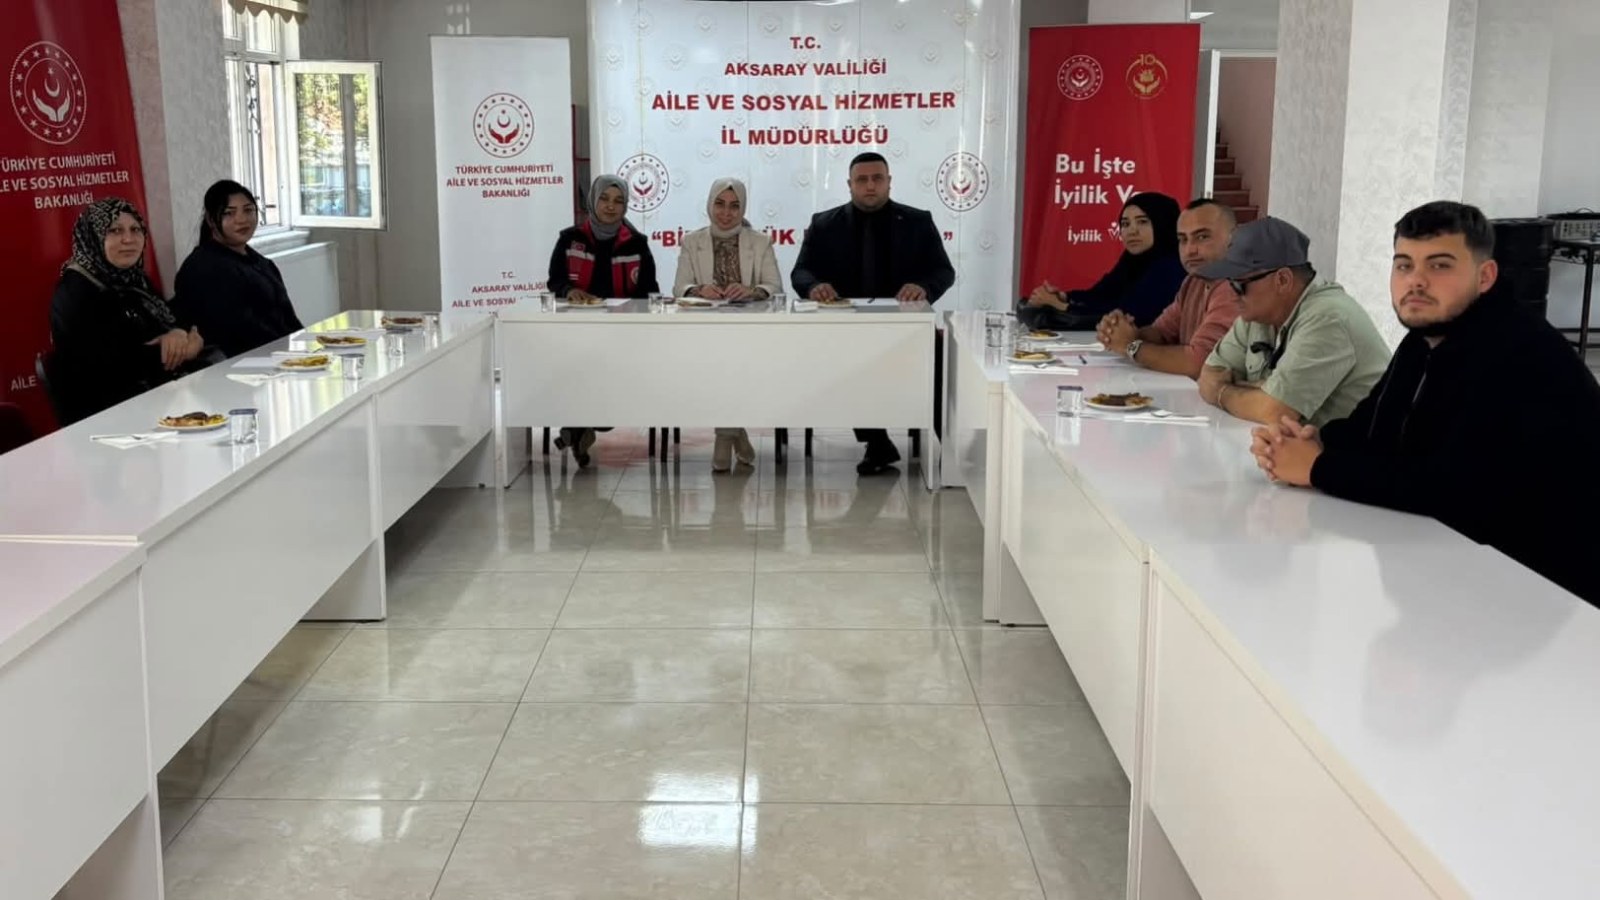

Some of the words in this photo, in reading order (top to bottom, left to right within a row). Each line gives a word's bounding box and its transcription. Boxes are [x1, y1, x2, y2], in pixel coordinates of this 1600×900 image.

[789, 36, 821, 49] T.C.
[724, 62, 807, 76] AKSARAY
[813, 58, 887, 76] VALİLİĞİ
[652, 90, 699, 110] AİLE
[706, 94, 734, 110] VE
[742, 94, 828, 111] SOSYAL
[835, 90, 956, 110] HİZMETLER
[721, 125, 741, 145] İL
[748, 125, 888, 145] MÜDÜRLÜĞÜ
[0, 155, 46, 172] ÜRKİYE
[49, 151, 116, 169] CUMHURİYETİ
[456, 164, 492, 174] TÜRKİYE
[495, 163, 554, 174] CUMHURİYETİ
[1056, 153, 1084, 174] Bu
[1094, 148, 1136, 179] İşte
[11, 177, 28, 191] VE
[30, 174, 75, 190] SOSYAL
[76, 170, 129, 187] HİZMETLER
[447, 178, 465, 187] AİLE
[467, 178, 478, 186] VE
[481, 177, 513, 186] SOSYAL
[515, 175, 563, 185] HİZMETLER
[34, 189, 94, 209] BAKANLIĞI
[482, 188, 530, 198] BAKANLIĞI
[1055, 179, 1108, 209] İyilik
[1068, 226, 1102, 245] İyilik
[472, 285, 510, 293] AKSARAY
[452, 299, 470, 308] AİLE
[473, 299, 483, 307] VE
